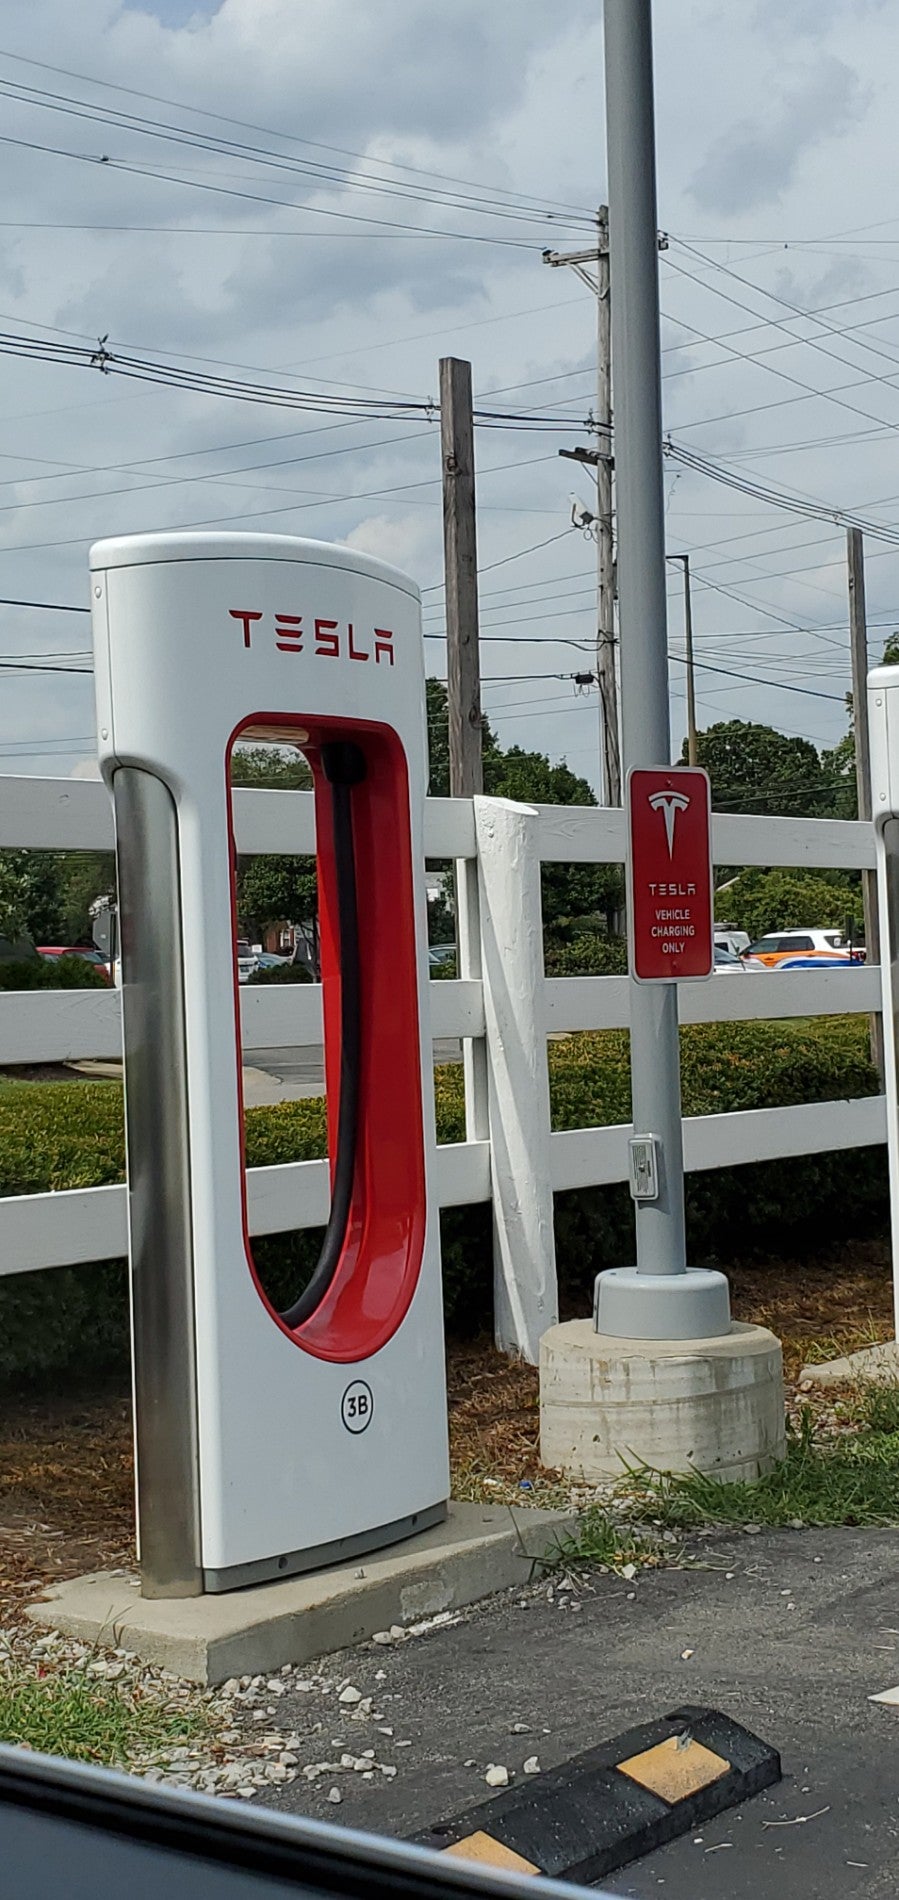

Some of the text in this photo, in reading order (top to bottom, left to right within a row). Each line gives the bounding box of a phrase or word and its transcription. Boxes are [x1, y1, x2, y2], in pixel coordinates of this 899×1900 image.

[228, 609, 394, 666] TESLA
[649, 883, 696, 896] TESLA
[655, 909, 691, 920] VEHICLE
[651, 925, 695, 937] CHARGING
[662, 942, 685, 953] ONLY
[347, 1395, 368, 1417] 3B
